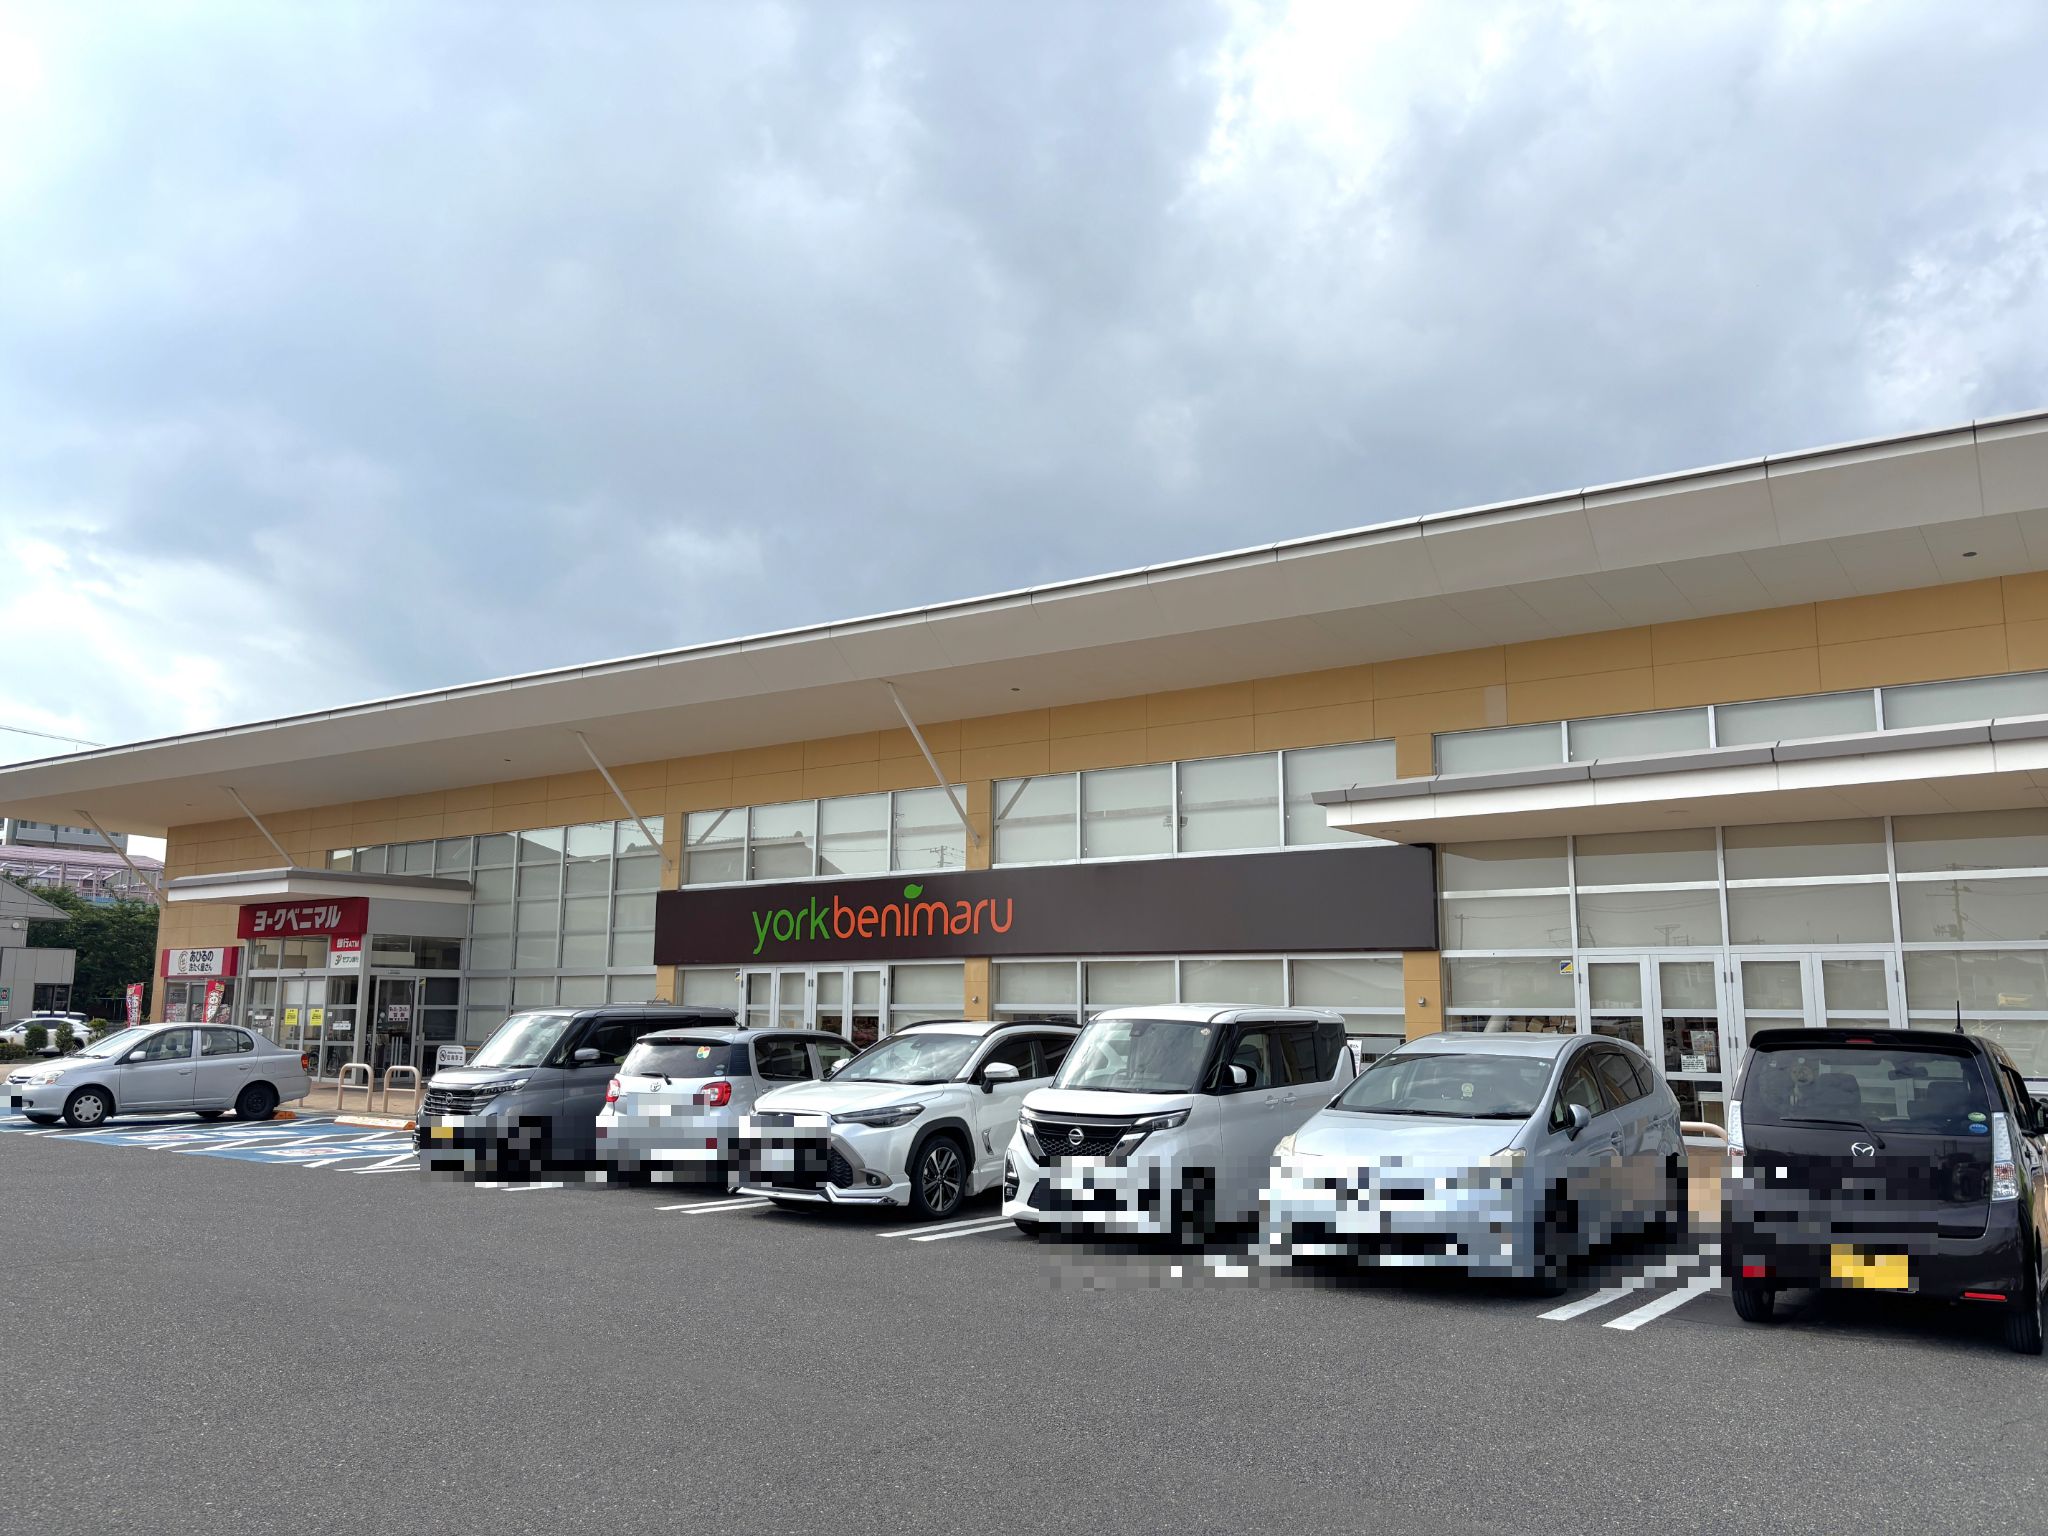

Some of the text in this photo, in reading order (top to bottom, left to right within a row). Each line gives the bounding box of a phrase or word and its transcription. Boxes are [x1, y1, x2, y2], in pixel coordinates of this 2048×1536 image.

[253, 905, 342, 932] ヨークベニマル
[189, 950, 214, 962] あひるの
